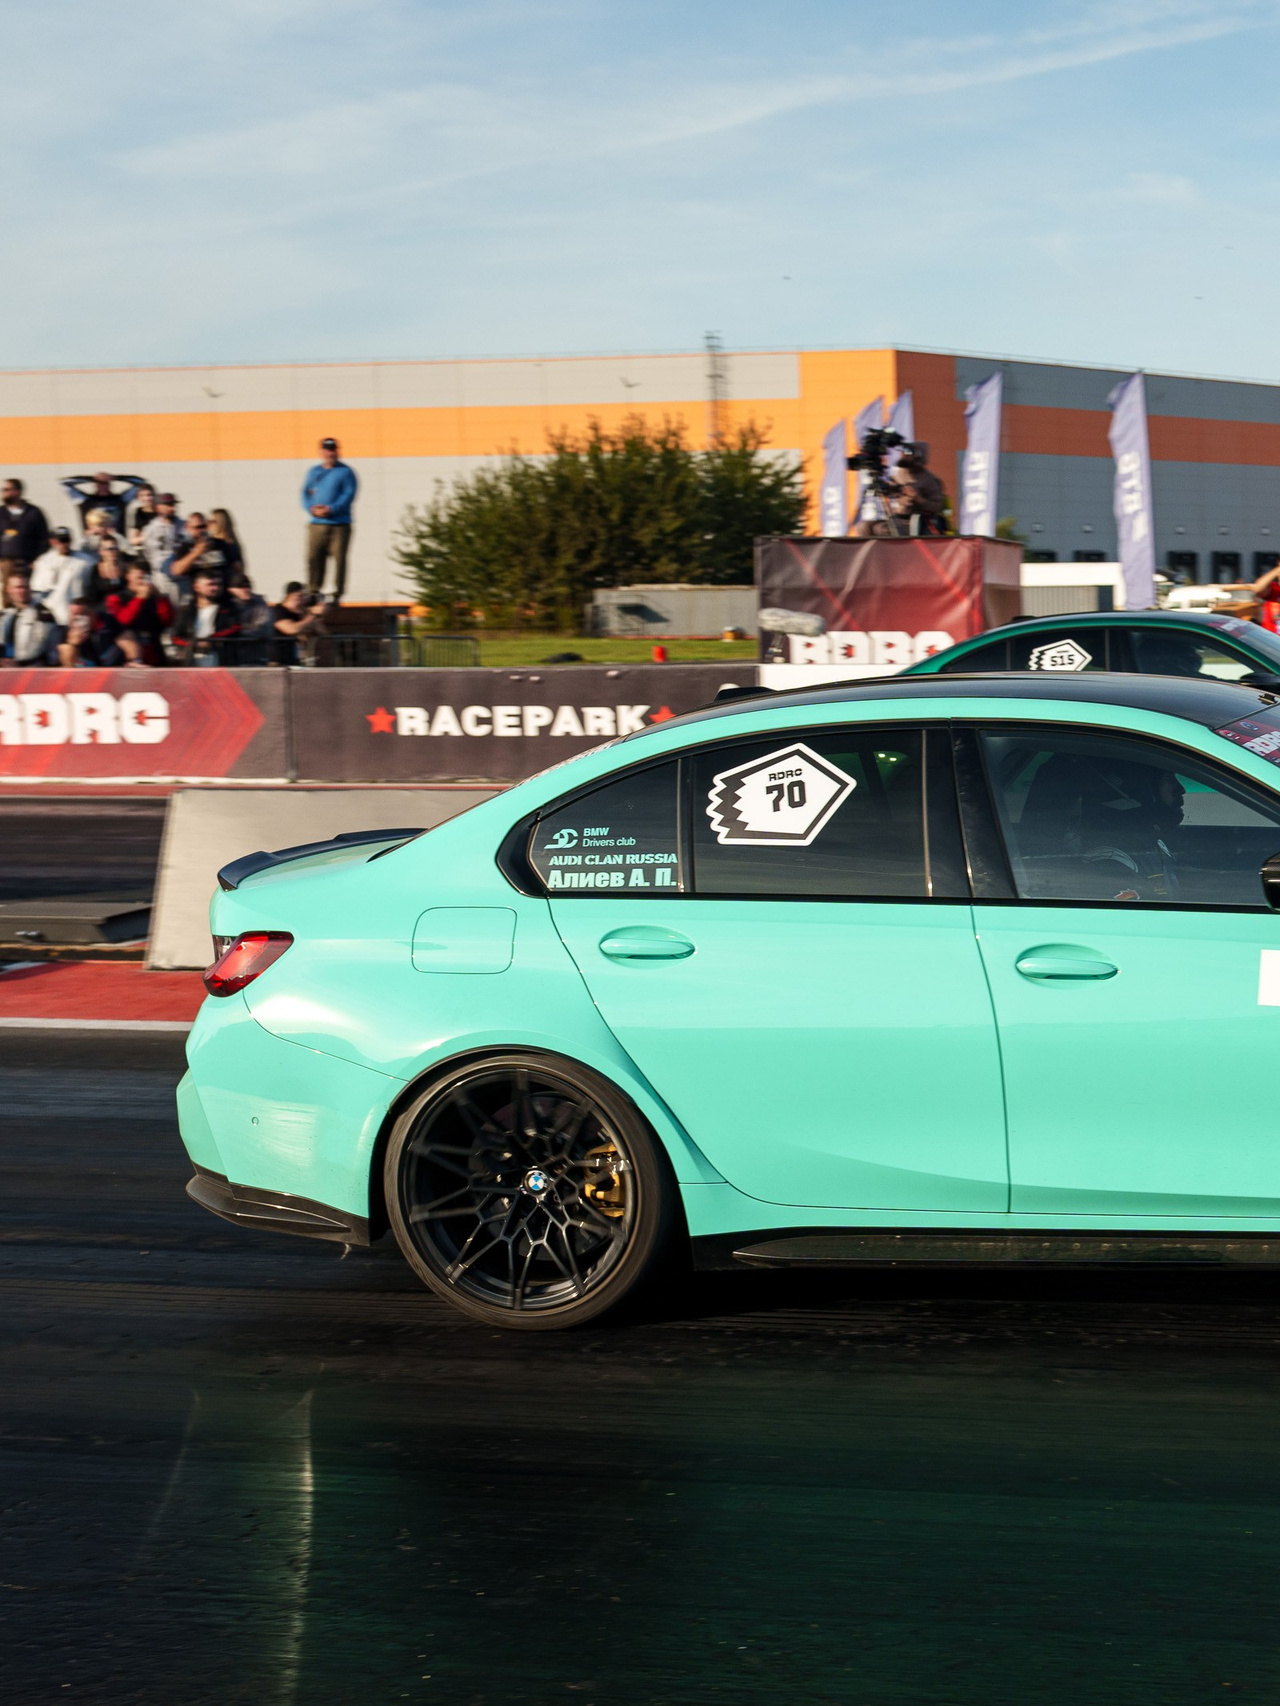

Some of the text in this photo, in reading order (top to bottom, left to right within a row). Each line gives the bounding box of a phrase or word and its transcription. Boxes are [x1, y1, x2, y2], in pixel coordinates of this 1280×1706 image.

[395, 705, 651, 736] RACEPARK
[768, 768, 803, 781] RDRC
[765, 780, 806, 812] 70
[583, 827, 610, 837] BMW
[582, 837, 637, 847] Drivers club
[549, 853, 678, 866] AUDI CLAN RUSSIA
[547, 869, 625, 888] Алиев
